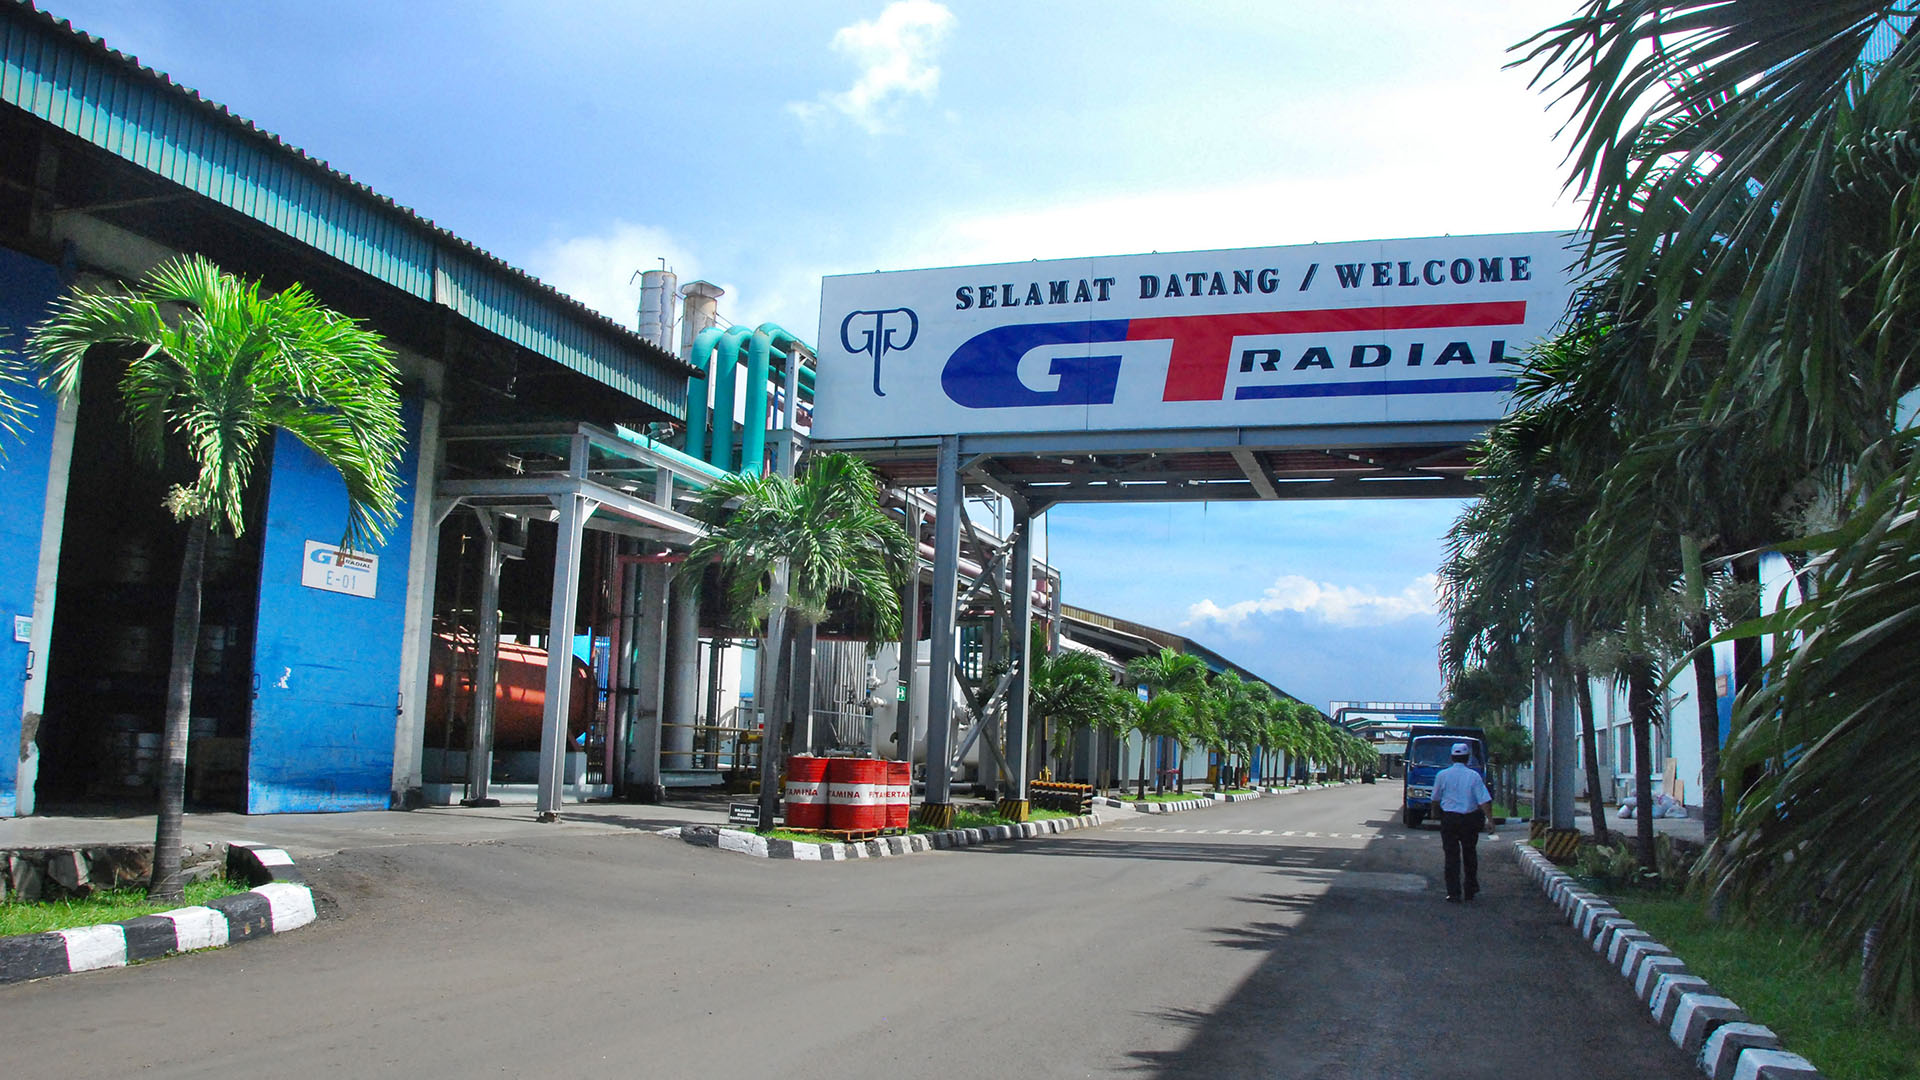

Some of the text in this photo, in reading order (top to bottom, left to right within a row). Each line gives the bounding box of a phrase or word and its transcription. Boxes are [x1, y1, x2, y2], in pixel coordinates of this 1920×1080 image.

[955, 256, 1531, 310] SELAMAT DATANG / WELCOME
[1240, 339, 1521, 373] RADIAL
[344, 560, 371, 569] RADIAL
[326, 570, 356, 590] E-01
